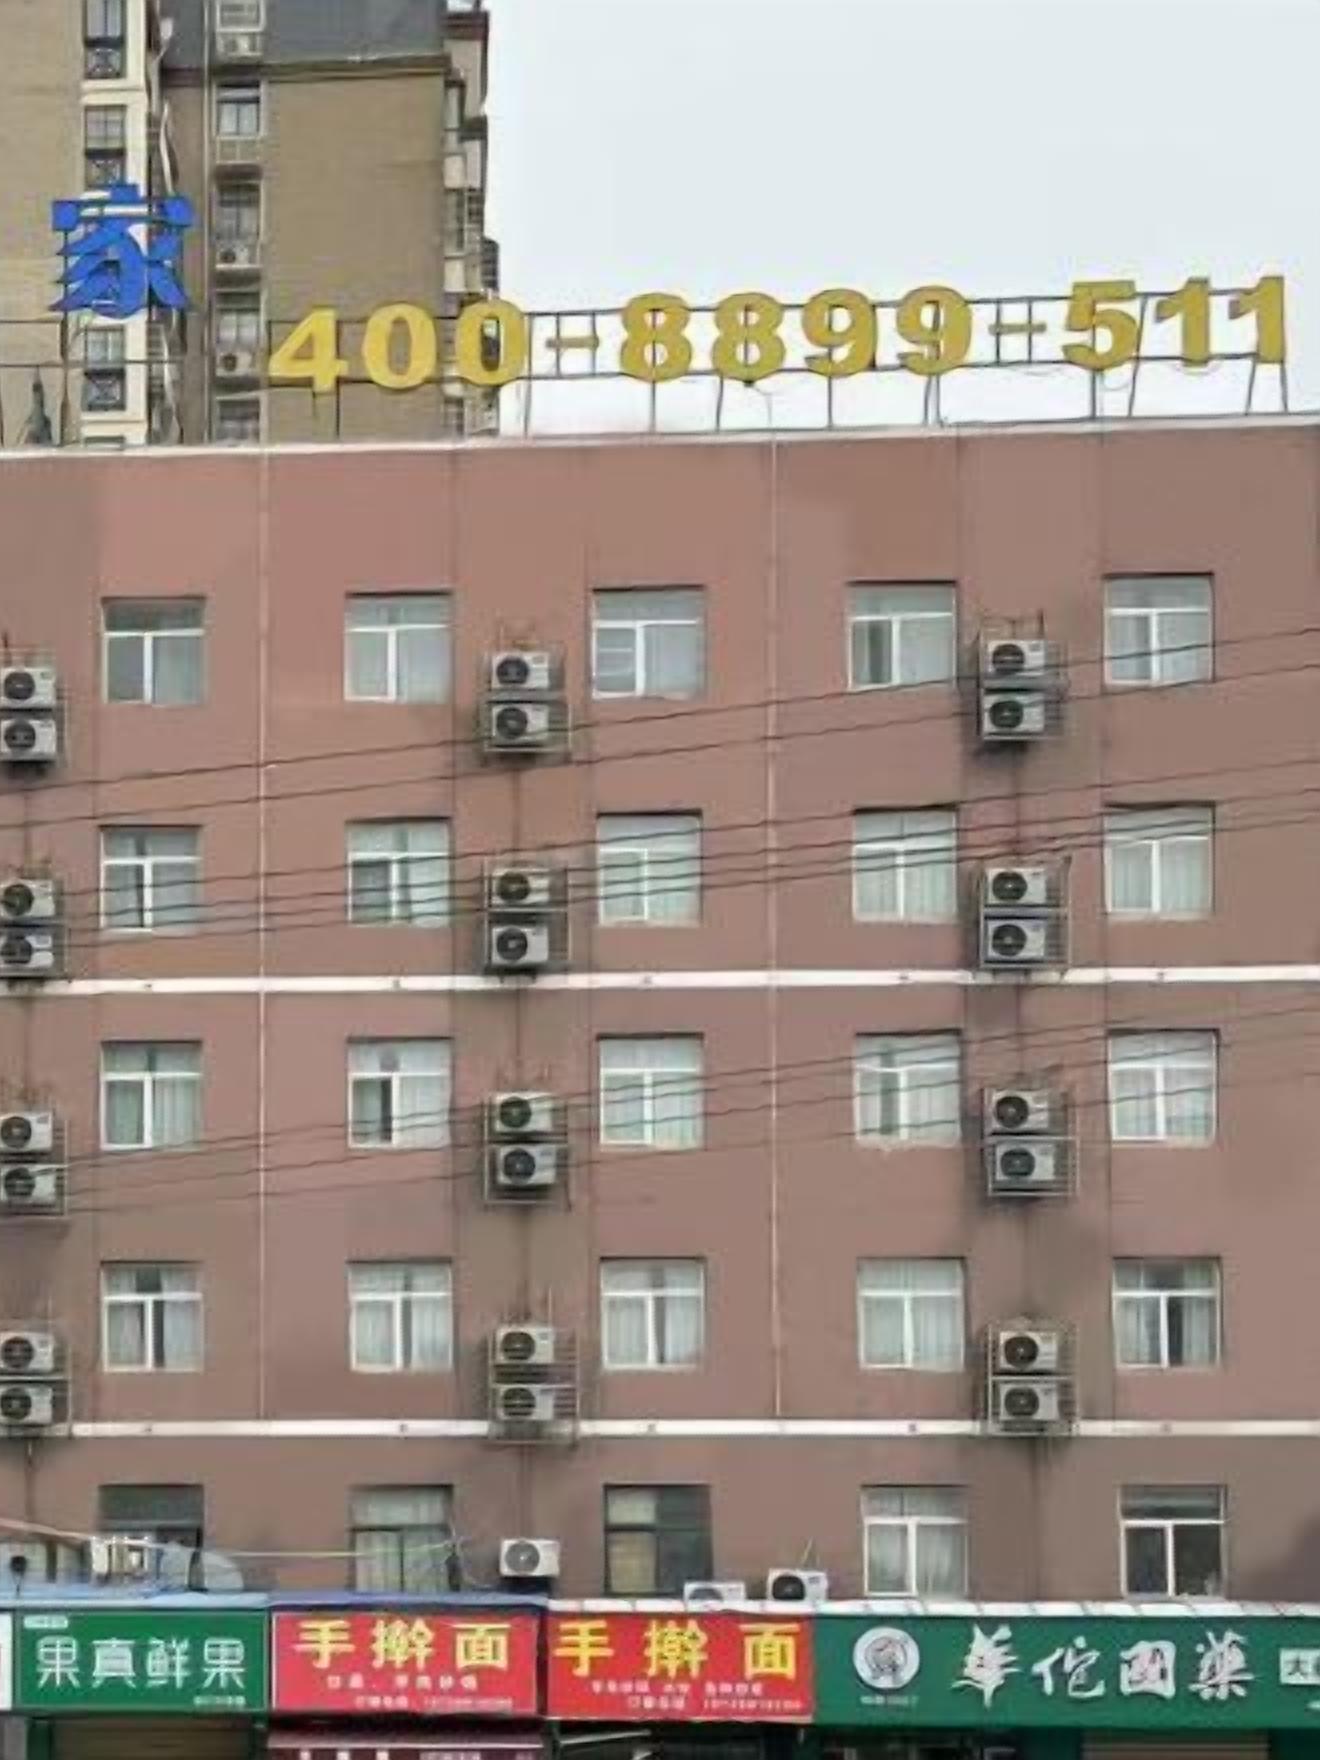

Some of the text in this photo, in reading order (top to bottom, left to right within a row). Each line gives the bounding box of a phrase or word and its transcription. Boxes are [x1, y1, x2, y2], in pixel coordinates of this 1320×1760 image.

[267, 274, 1287, 393] 400-8899-511
[36, 1634, 246, 1689] 果真鲜果
